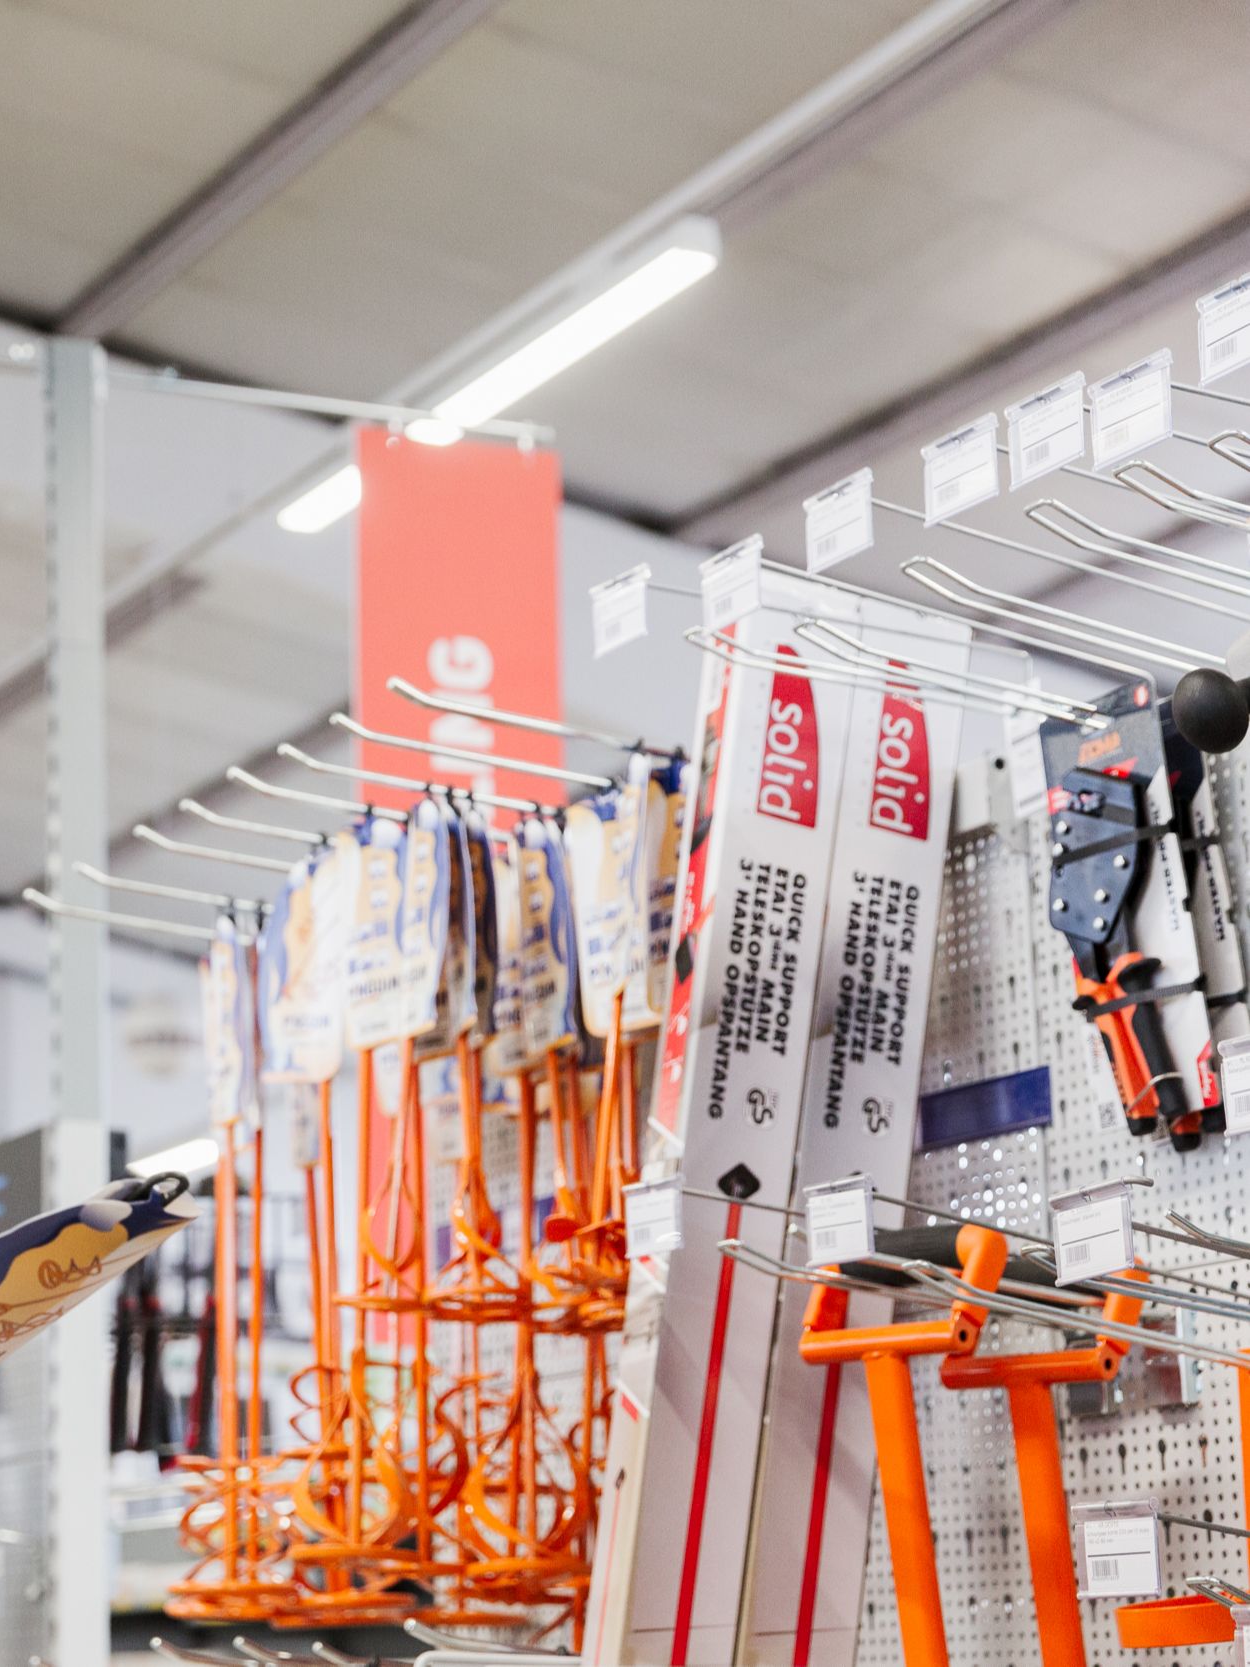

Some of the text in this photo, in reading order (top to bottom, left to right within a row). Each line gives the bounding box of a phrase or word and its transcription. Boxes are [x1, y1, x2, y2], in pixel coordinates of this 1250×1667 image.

[758, 698, 813, 820] solid
[871, 712, 925, 833] solid
[730, 888, 749, 954] HAND
[772, 868, 789, 914] ETAI
[843, 901, 862, 966] HAND
[885, 880, 901, 925] ETAI
[755, 977, 775, 1042] MAIN
[772, 873, 807, 1056] QUICK SUPPORT
[887, 885, 919, 1065] QUICK SUPPORT
[708, 964, 740, 1120] OPSPANTANG
[824, 974, 854, 1129] OPSPANTANG
[870, 989, 889, 1053] MAIN
